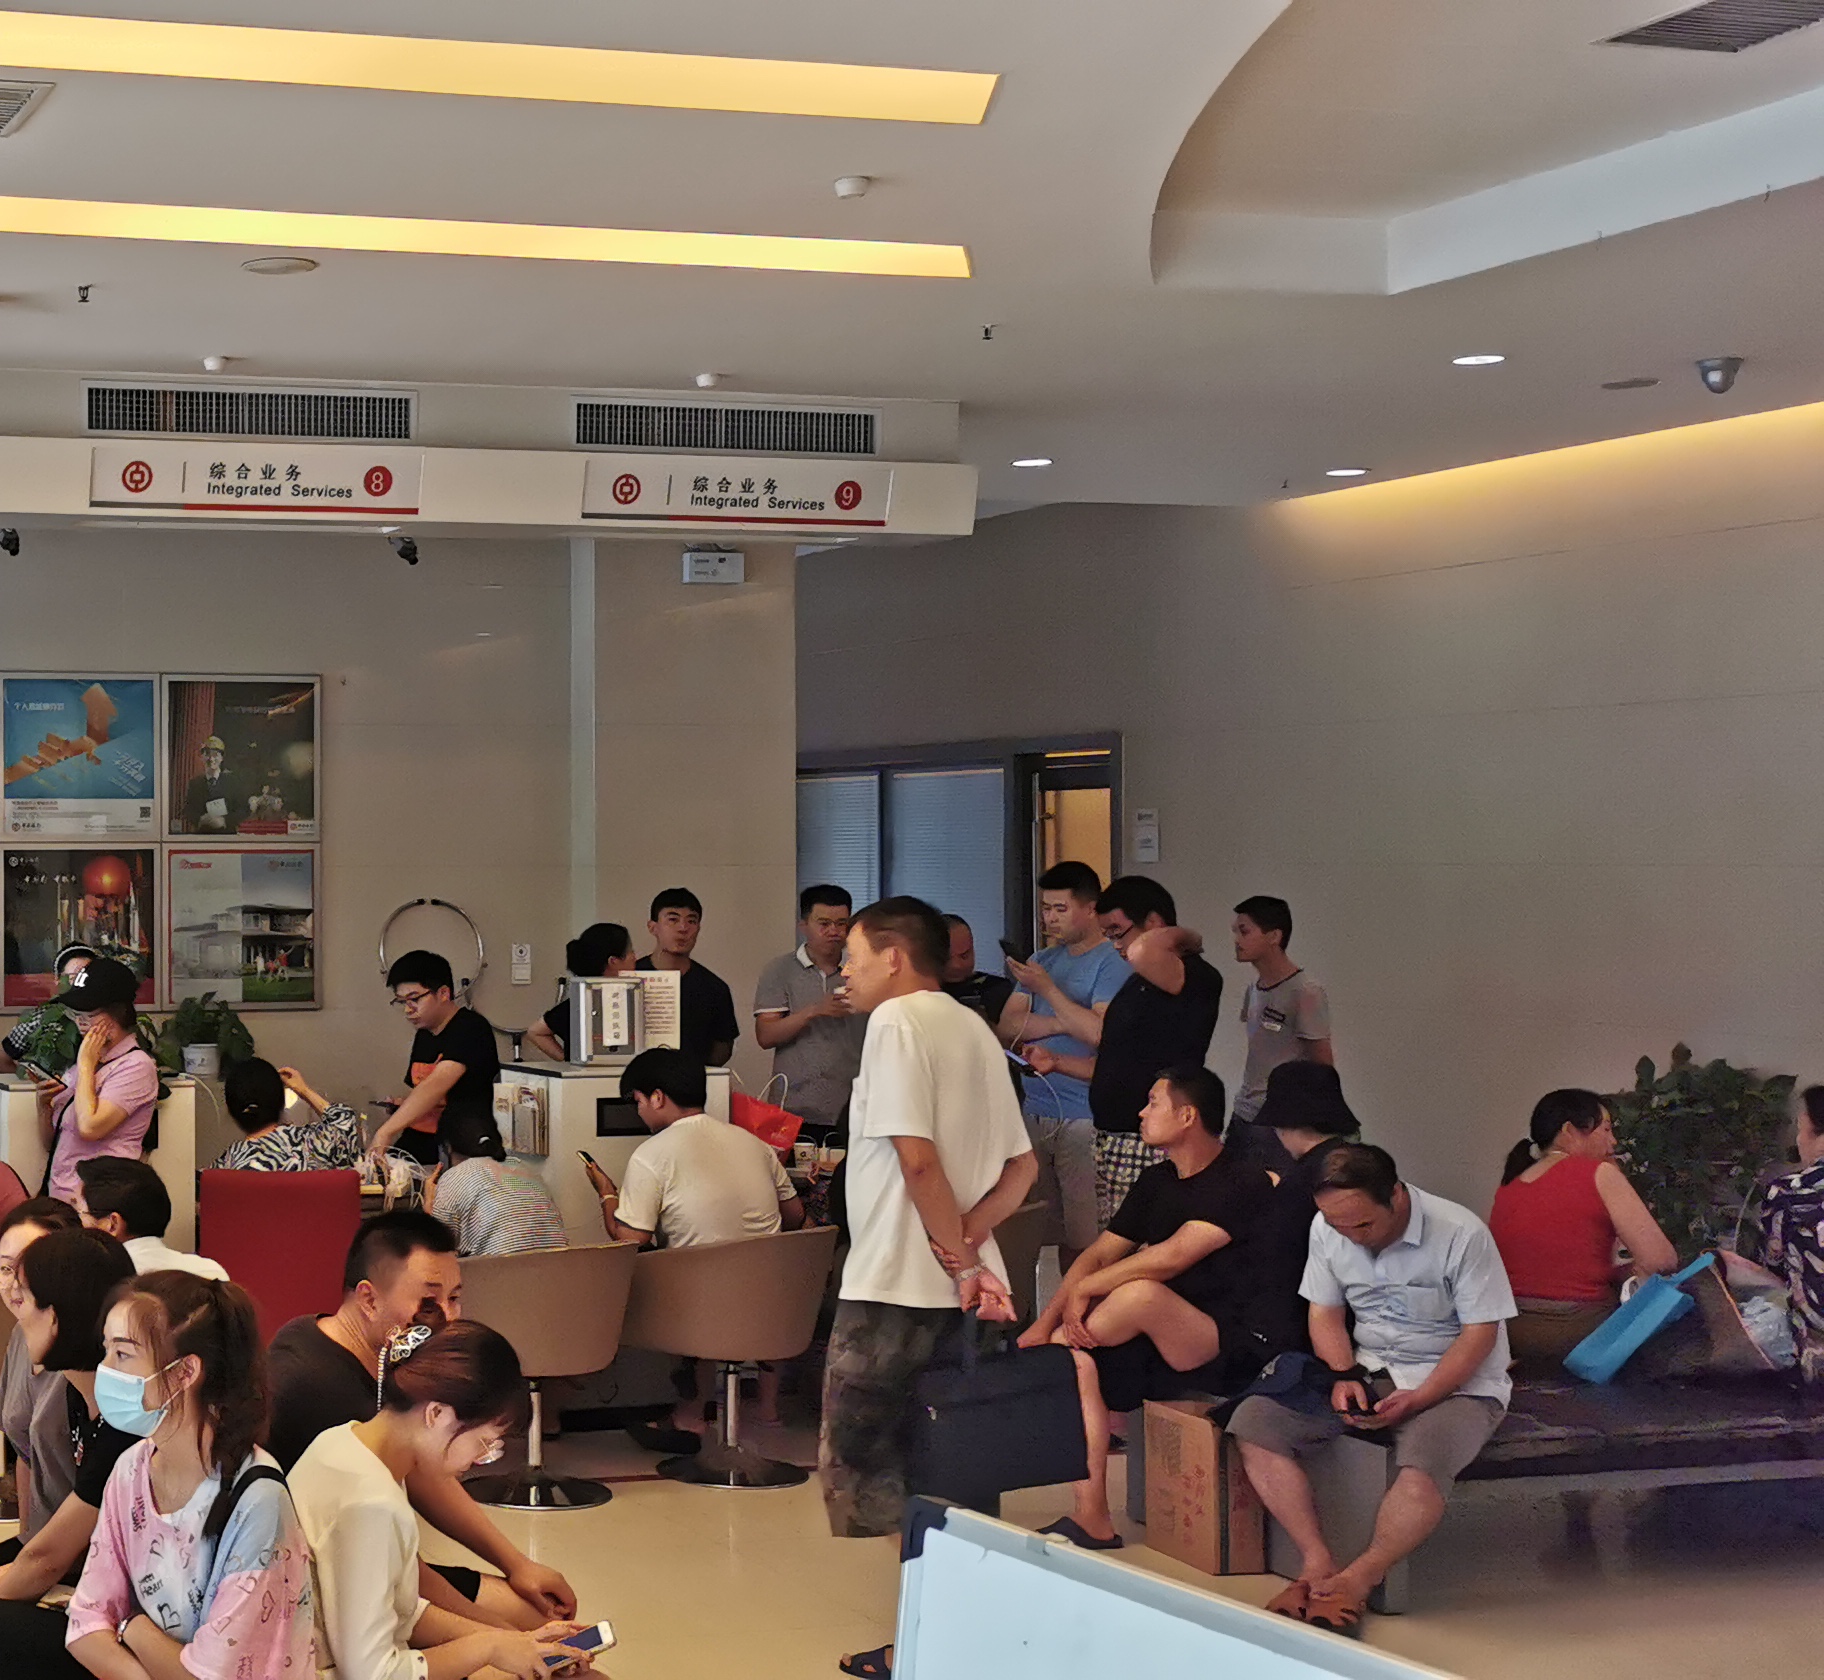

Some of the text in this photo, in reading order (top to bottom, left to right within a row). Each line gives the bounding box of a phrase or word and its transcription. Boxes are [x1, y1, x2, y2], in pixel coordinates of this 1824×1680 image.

[208, 461, 302, 482] 综合业务
[207, 482, 353, 500] Integrated Services
[692, 475, 779, 496] 综合业务
[690, 493, 826, 512] Integrated Services
